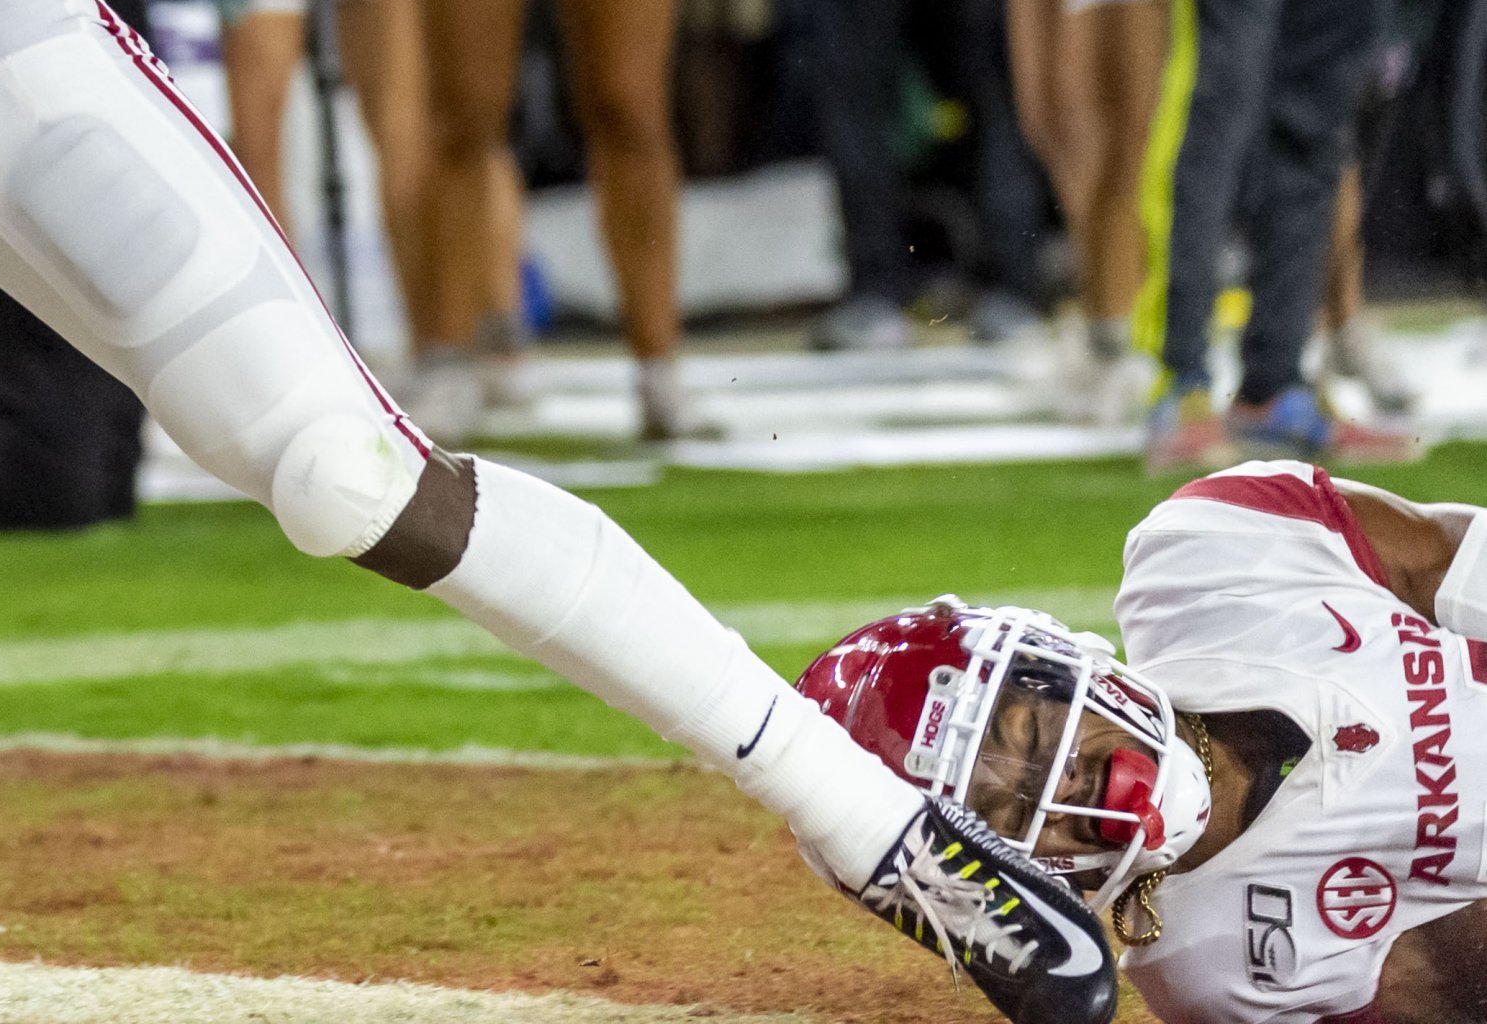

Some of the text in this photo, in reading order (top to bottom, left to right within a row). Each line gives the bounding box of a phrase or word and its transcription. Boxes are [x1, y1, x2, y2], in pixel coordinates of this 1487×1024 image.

[920, 699, 946, 748] HOGS
[1323, 865, 1392, 933] SEC
[1247, 883, 1297, 986] 150
